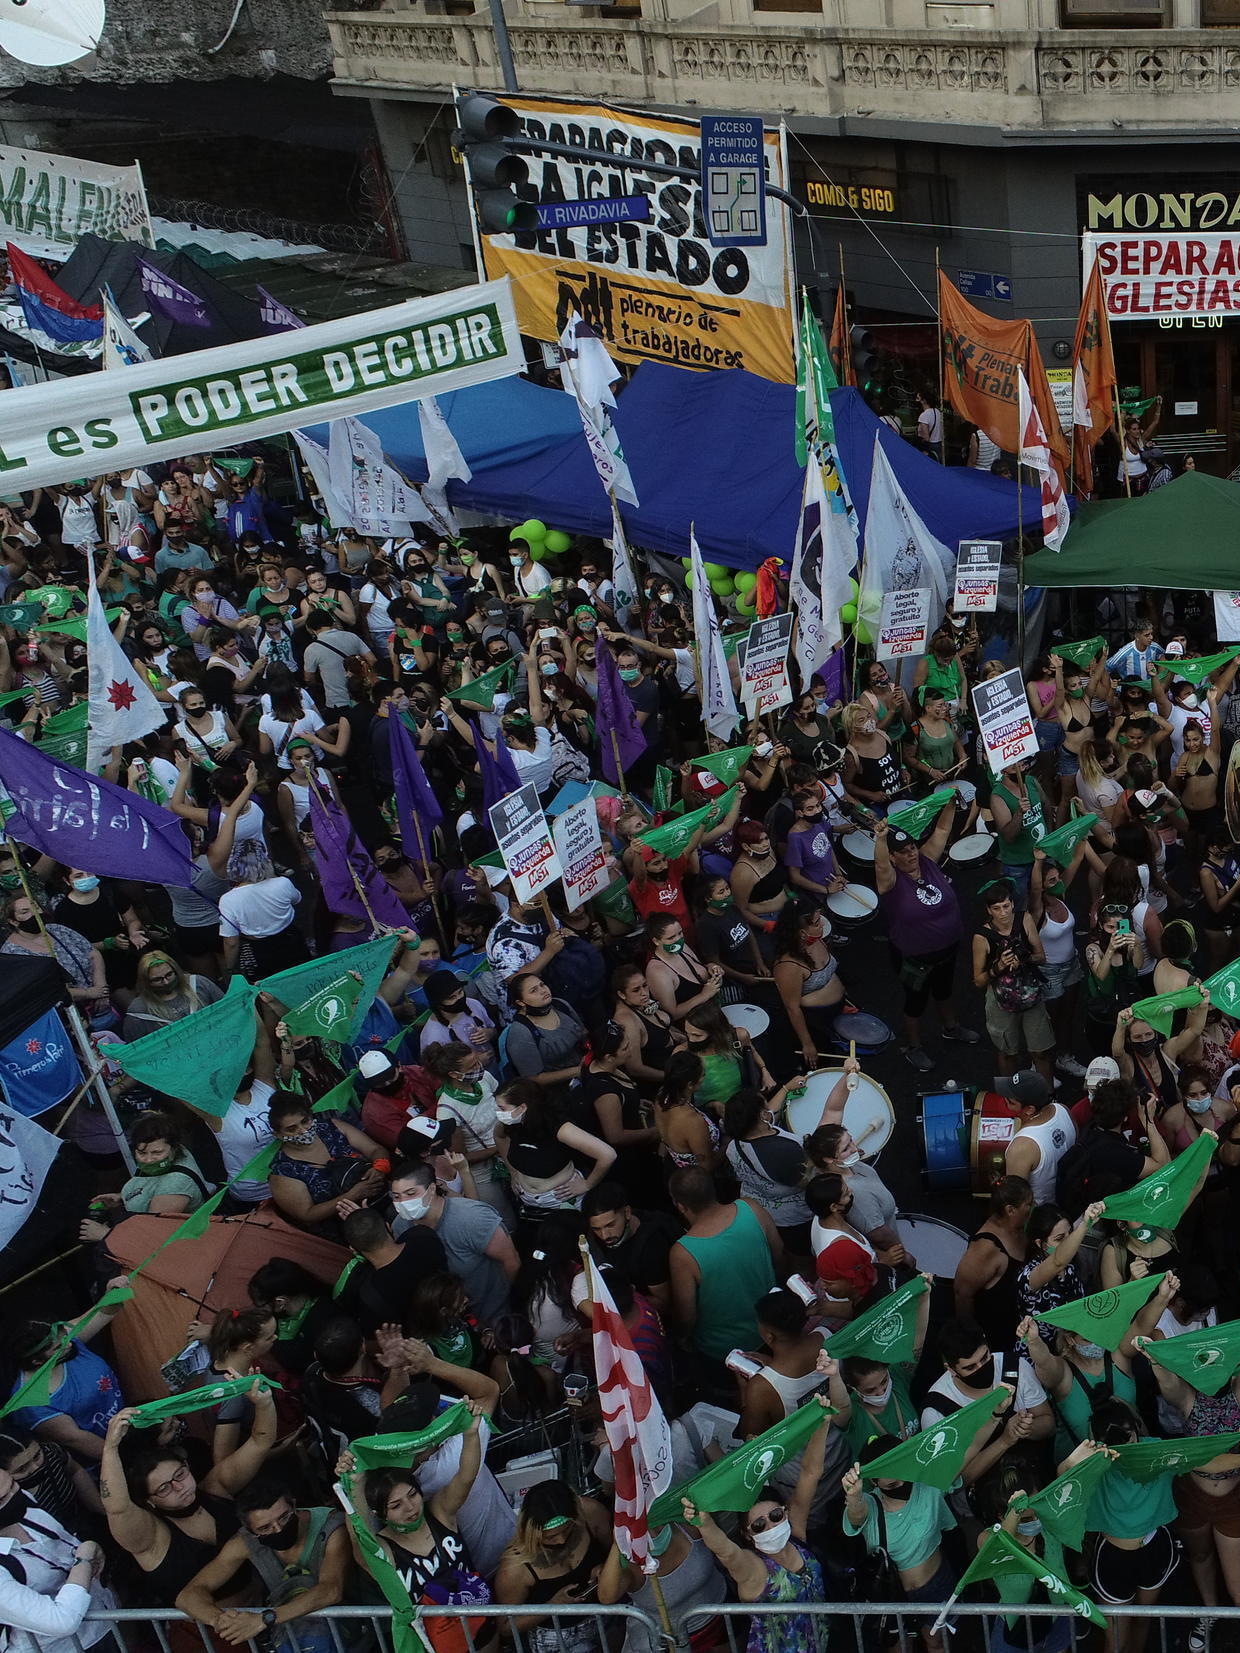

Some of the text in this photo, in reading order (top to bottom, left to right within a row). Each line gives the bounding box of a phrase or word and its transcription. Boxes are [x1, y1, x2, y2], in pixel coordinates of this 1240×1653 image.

[713, 121, 753, 133] ACCESO
[708, 137, 758, 148] PERMITIDO
[709, 153, 758, 163] A GARAGE
[806, 182, 845, 207] COMO
[861, 188, 895, 213] SIGO
[555, 202, 631, 224] RIVADAVIA
[698, 308, 719, 332] de
[621, 322, 745, 371] trabajadoras
[47, 416, 119, 458] es
[138, 363, 307, 436] PODER
[322, 311, 499, 393] DECIDIR
[893, 591, 920, 601] Aborto
[890, 608, 916, 617] seguro
[890, 613, 921, 625] gratuito
[877, 755, 893, 768] SOY
[884, 766, 894, 775] LA
[564, 808, 588, 830] Aborto
[565, 829, 588, 850] seguro
[567, 835, 595, 862] gratuito
